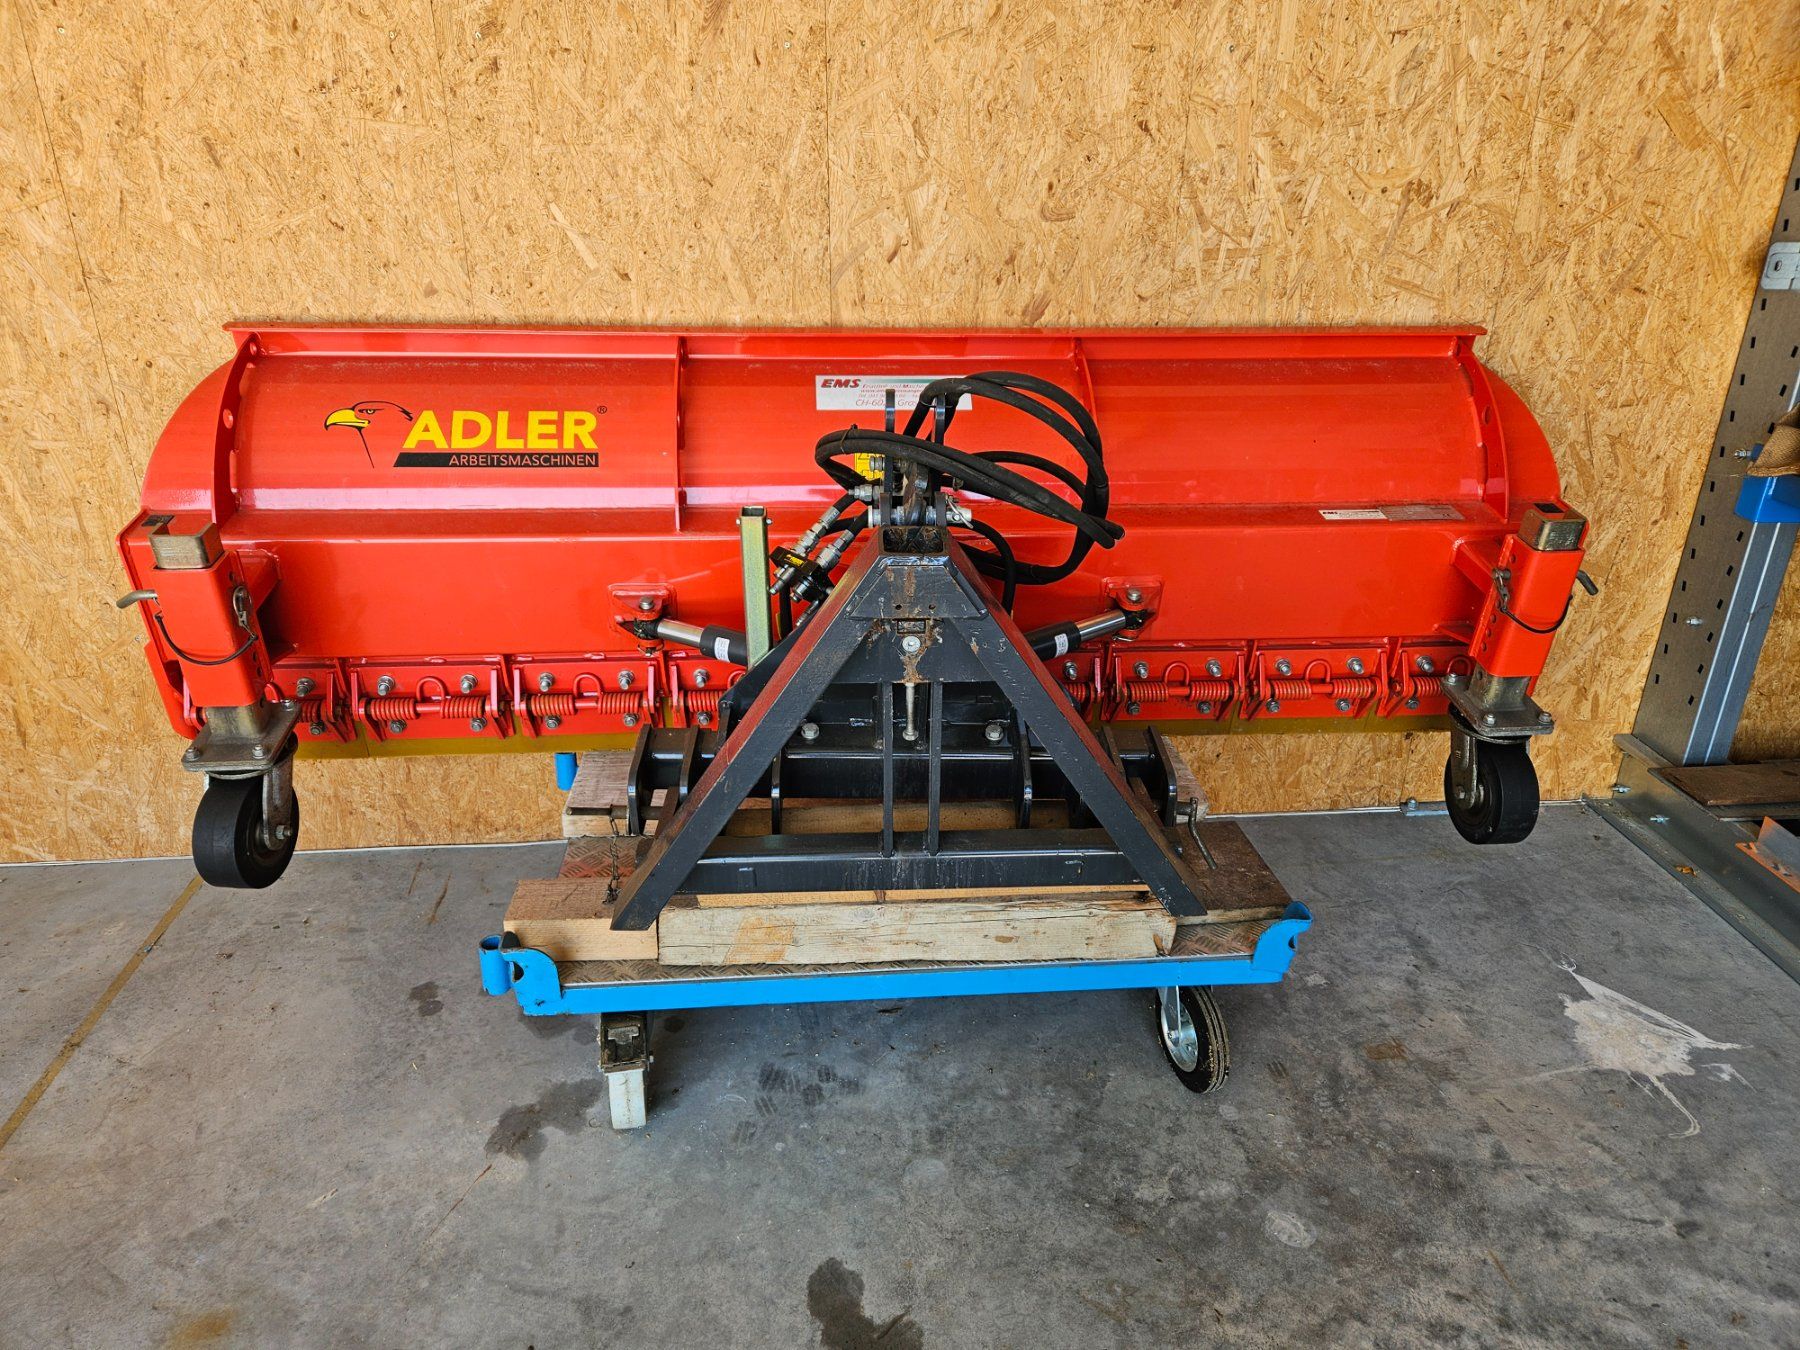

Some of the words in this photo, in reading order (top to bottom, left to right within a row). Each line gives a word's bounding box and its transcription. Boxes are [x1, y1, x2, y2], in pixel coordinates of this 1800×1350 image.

[820, 378, 861, 389] EMS
[855, 399, 886, 407] CH-60
[449, 454, 596, 466] ARBEITSMASCHINEN
